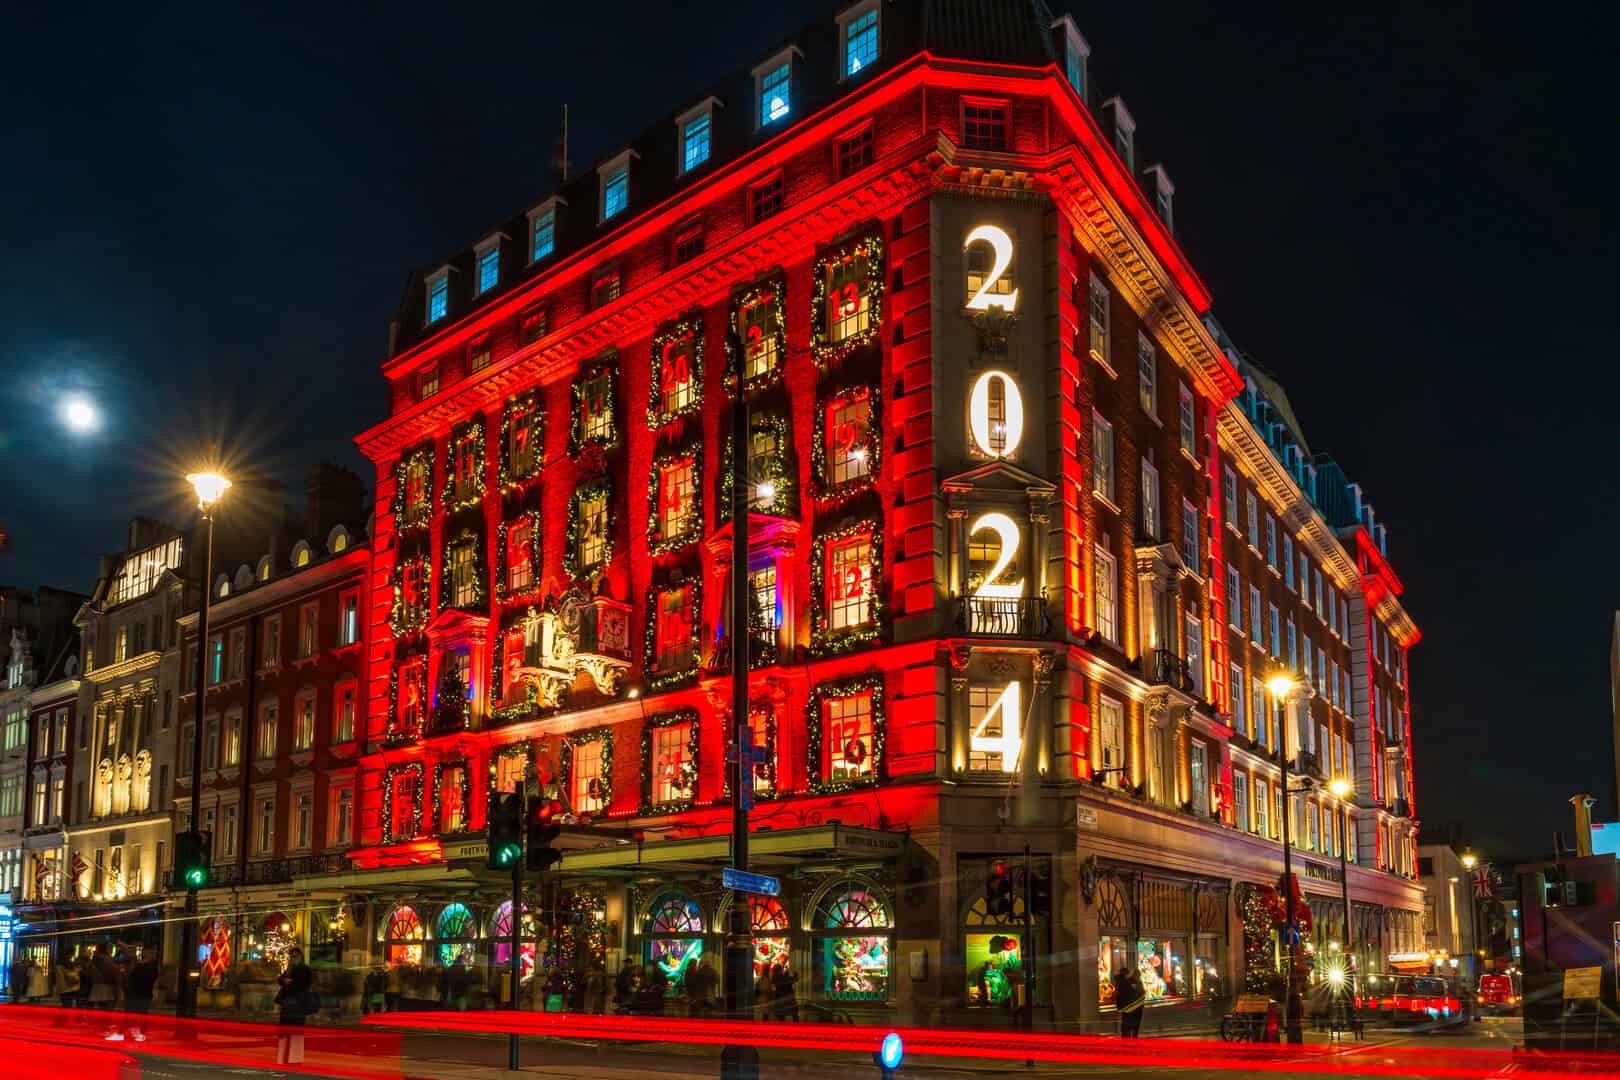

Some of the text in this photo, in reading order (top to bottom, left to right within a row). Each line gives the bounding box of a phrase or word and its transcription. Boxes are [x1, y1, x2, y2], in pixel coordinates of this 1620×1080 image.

[829, 282, 861, 321] 13
[747, 324, 764, 356] 2
[661, 354, 688, 392] 20
[515, 427, 529, 454] 7
[837, 422, 855, 456] 9
[963, 224, 1025, 774] 2024
[579, 511, 602, 544] 24
[833, 566, 864, 602] 12
[831, 720, 861, 757] 17
